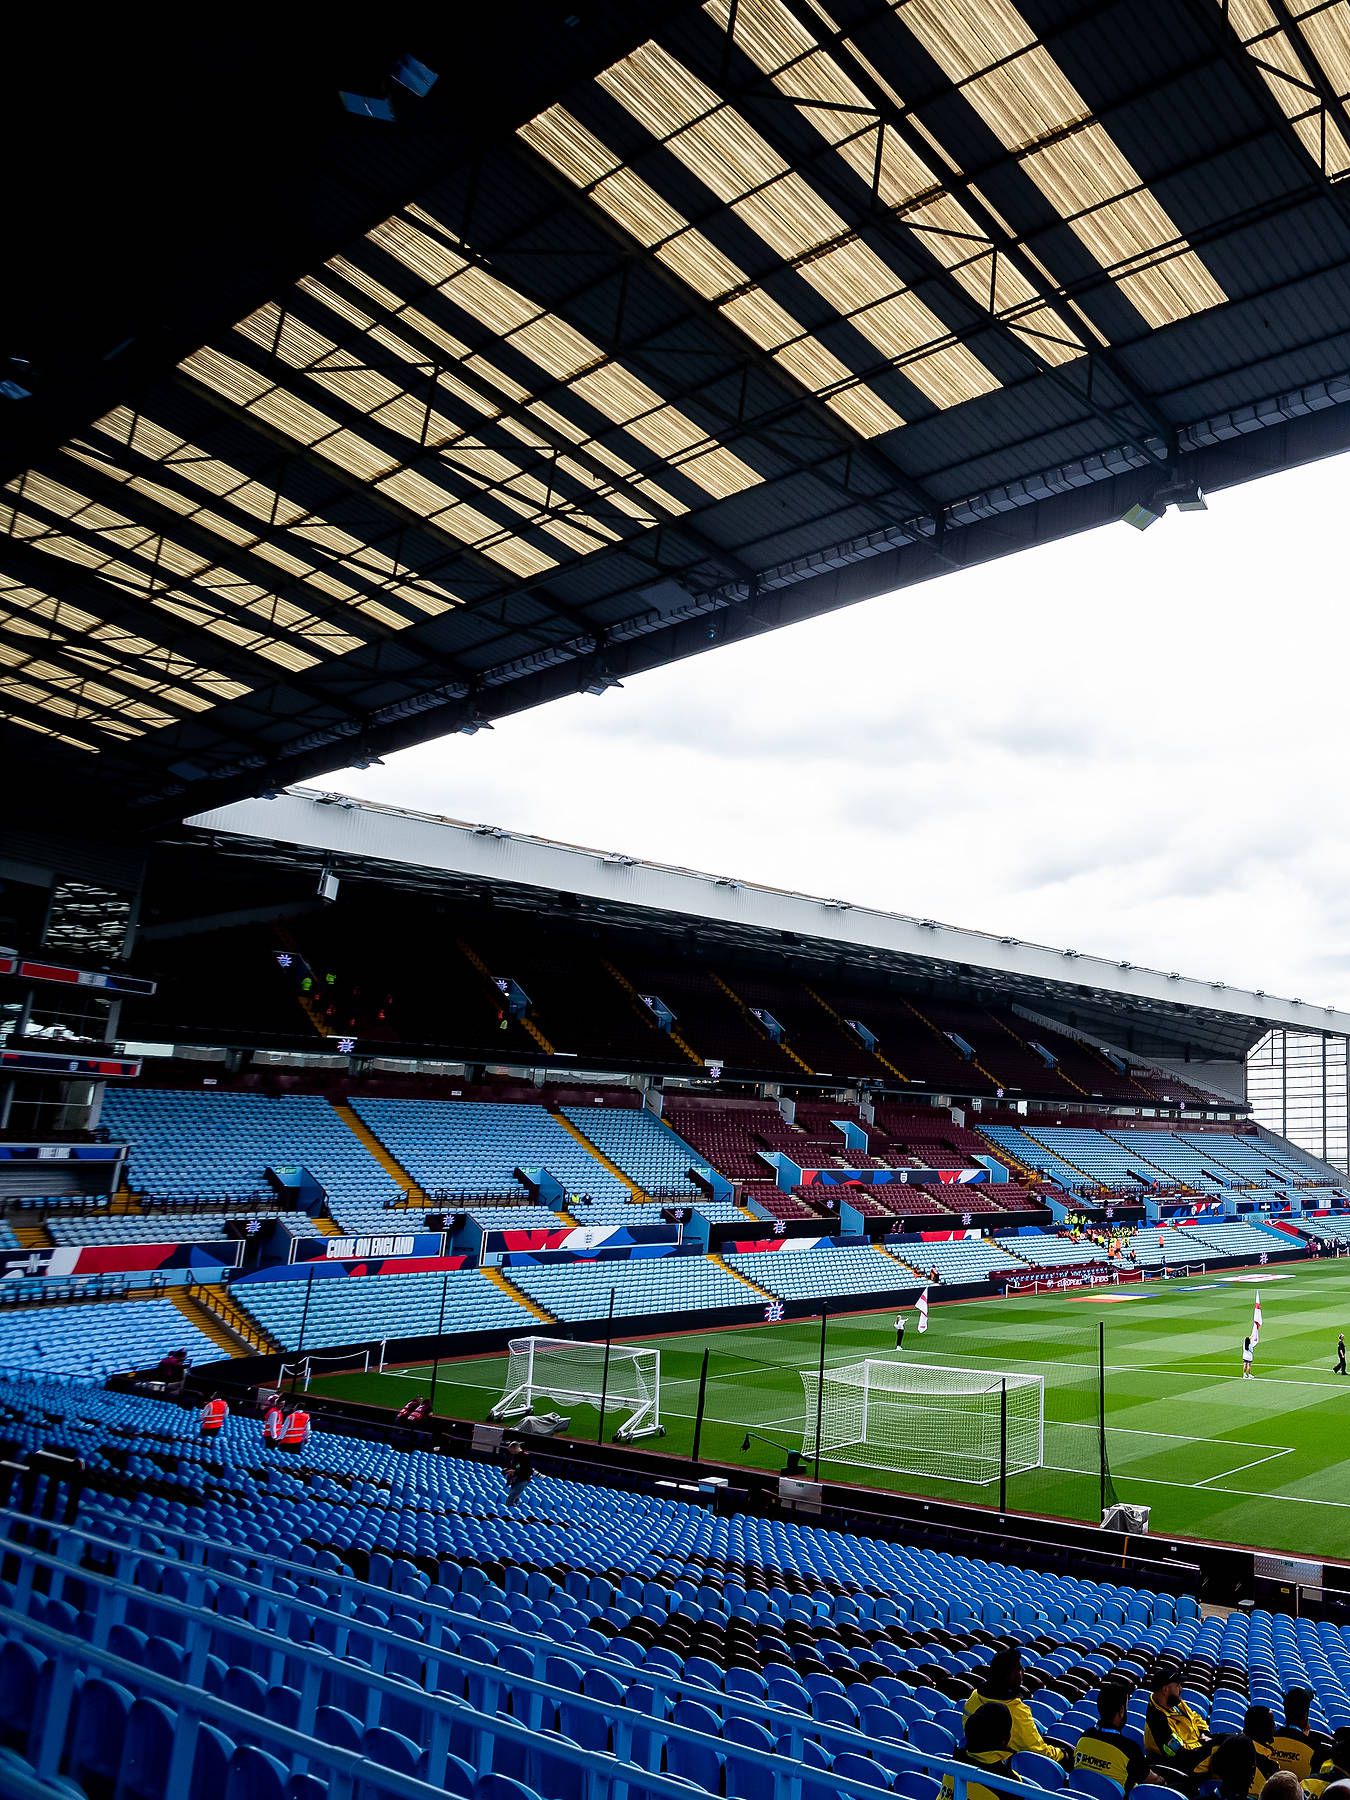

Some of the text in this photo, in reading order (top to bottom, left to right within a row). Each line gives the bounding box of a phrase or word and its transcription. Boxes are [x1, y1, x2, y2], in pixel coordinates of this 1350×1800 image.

[327, 1236, 415, 1258] COME ON ENGLAND
[1082, 1754, 1112, 1769] SHOWSEC
